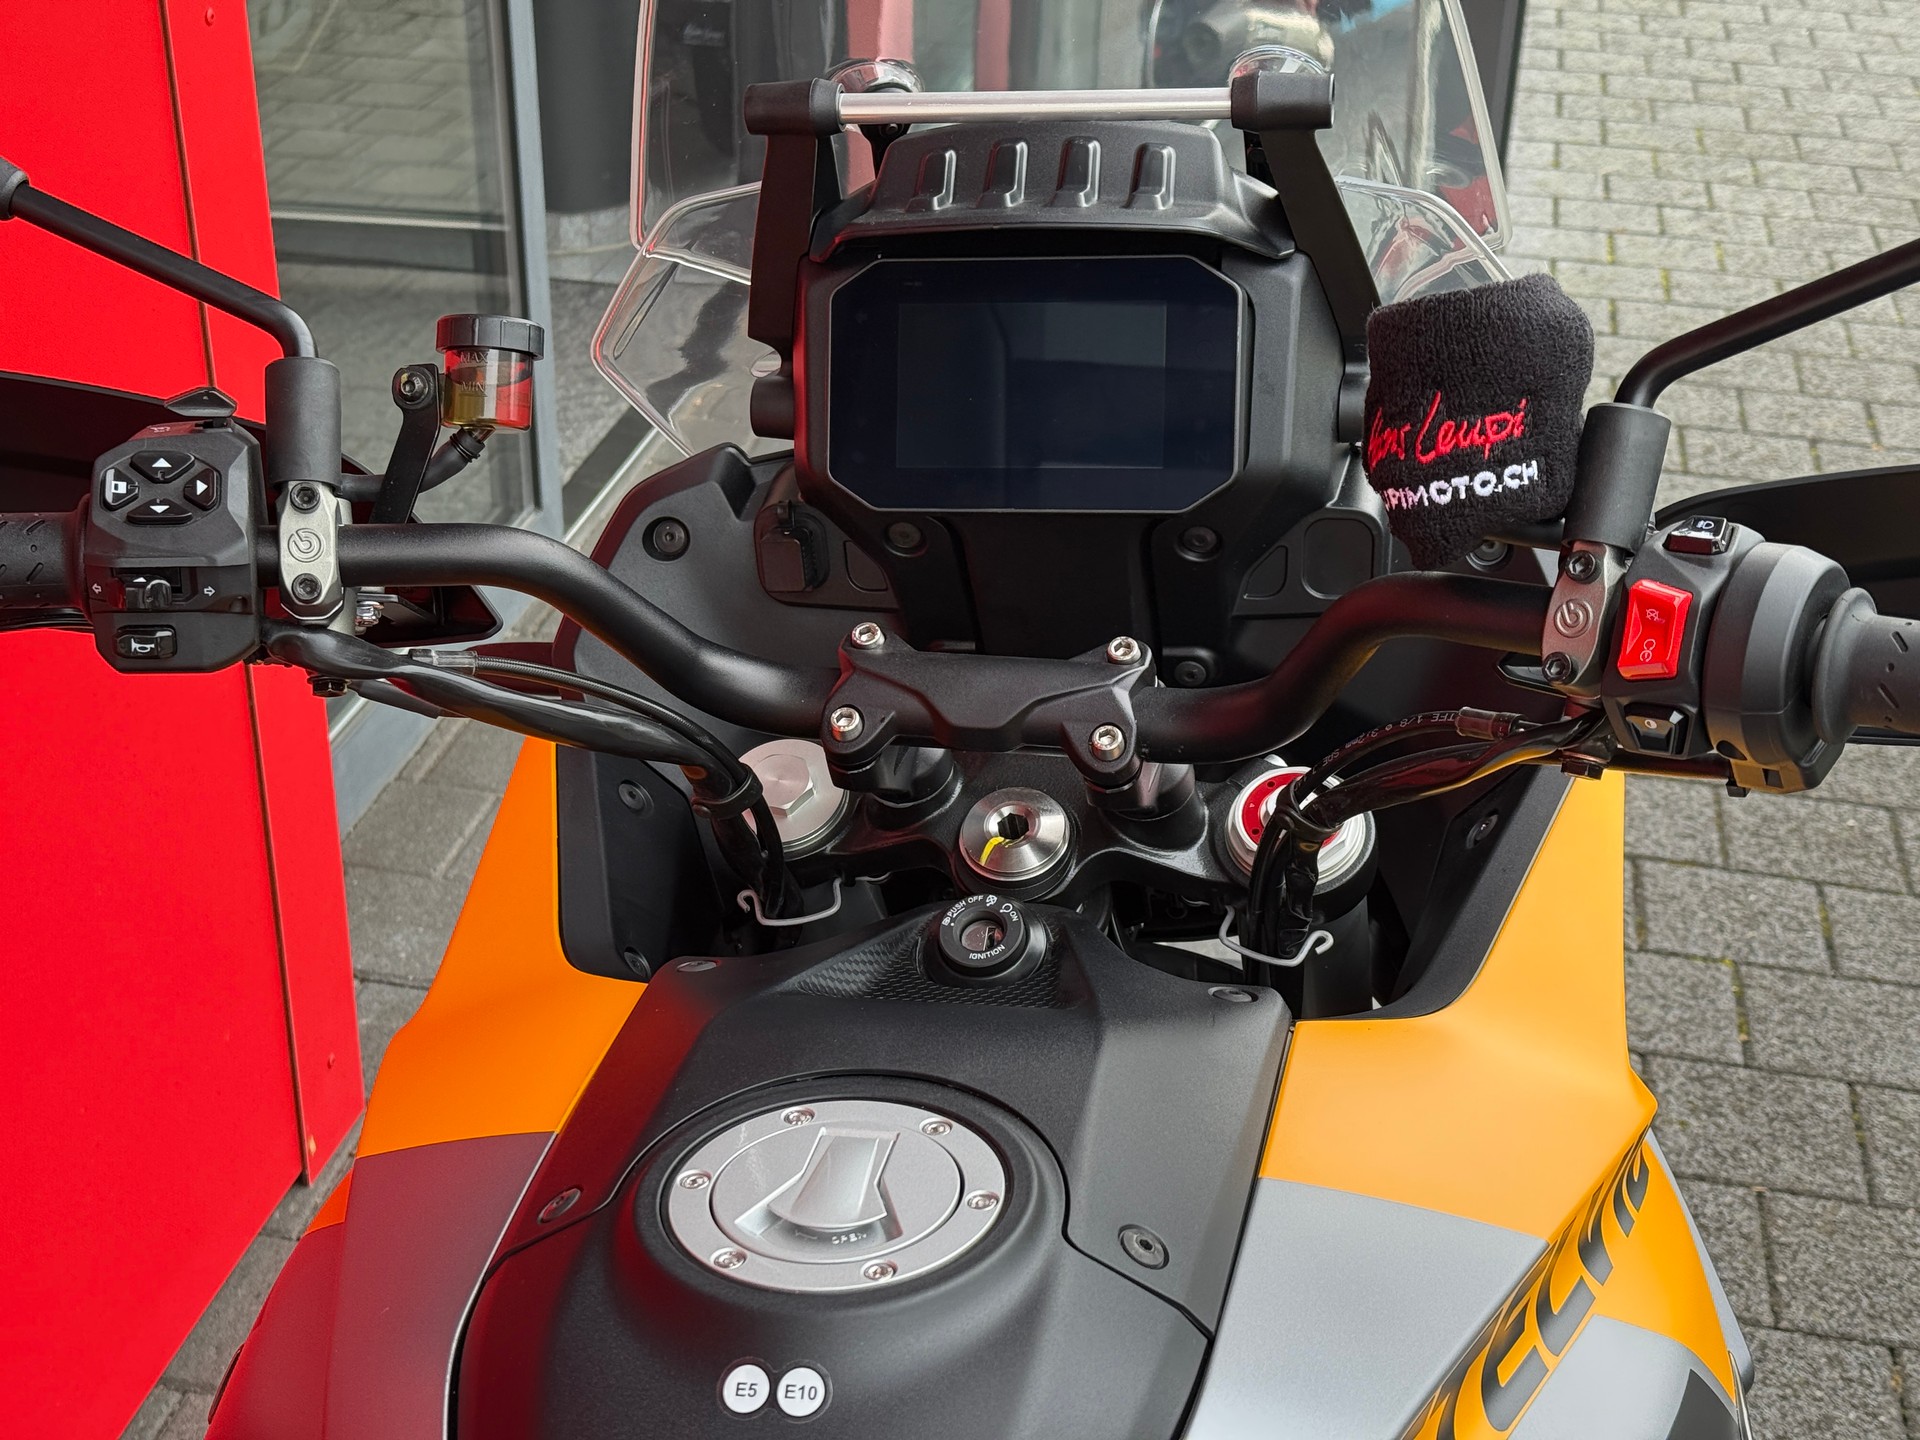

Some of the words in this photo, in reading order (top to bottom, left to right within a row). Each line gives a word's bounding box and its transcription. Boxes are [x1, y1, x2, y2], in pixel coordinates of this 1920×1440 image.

[460, 351, 489, 364] MAX
[461, 381, 486, 393] MIN
[1414, 390, 1528, 465] Leupi
[1383, 460, 1538, 511] PIMOTO.CH
[948, 900, 966, 917] PUSH
[967, 894, 984, 904] OFF
[1009, 910, 1019, 922] ON
[968, 944, 1006, 960] IGNITION
[1402, 1124, 1650, 1440] TELVIO
[735, 1382, 759, 1398] E5
[784, 1383, 818, 1401] E10
